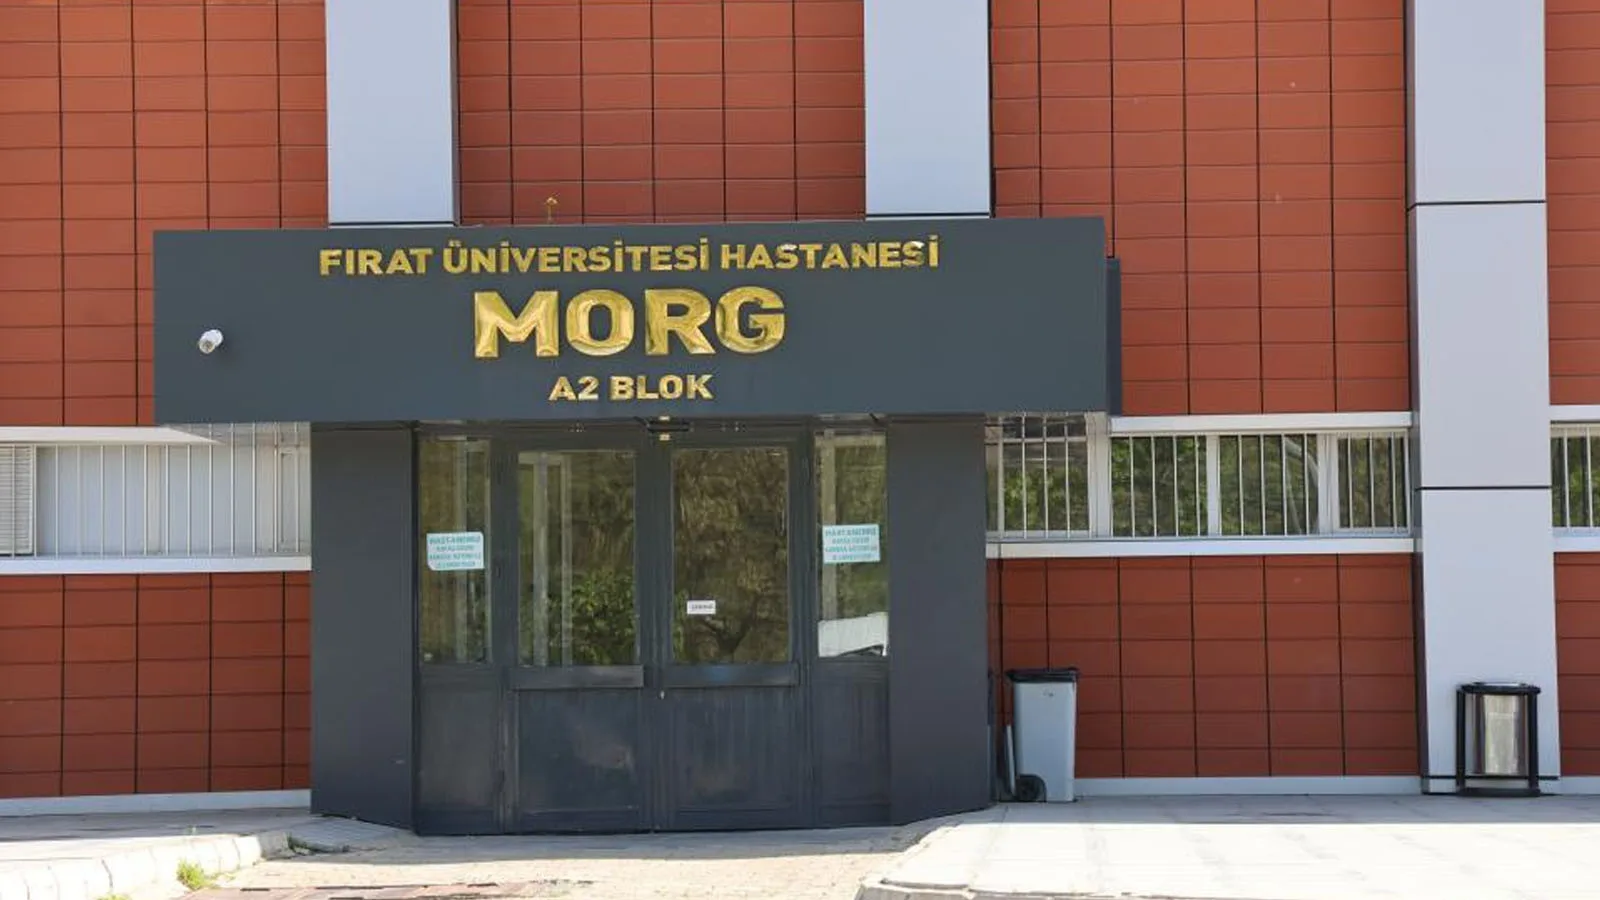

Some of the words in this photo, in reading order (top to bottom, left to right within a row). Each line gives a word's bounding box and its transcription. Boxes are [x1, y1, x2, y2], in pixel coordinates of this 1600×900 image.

[319, 248, 433, 275] FIRAT
[443, 238, 708, 273] ÜNİVERSİTESİ
[720, 235, 939, 269] HASTANESİ
[474, 286, 786, 358] MORG
[548, 376, 600, 401] A2
[610, 374, 714, 400] BLOK
